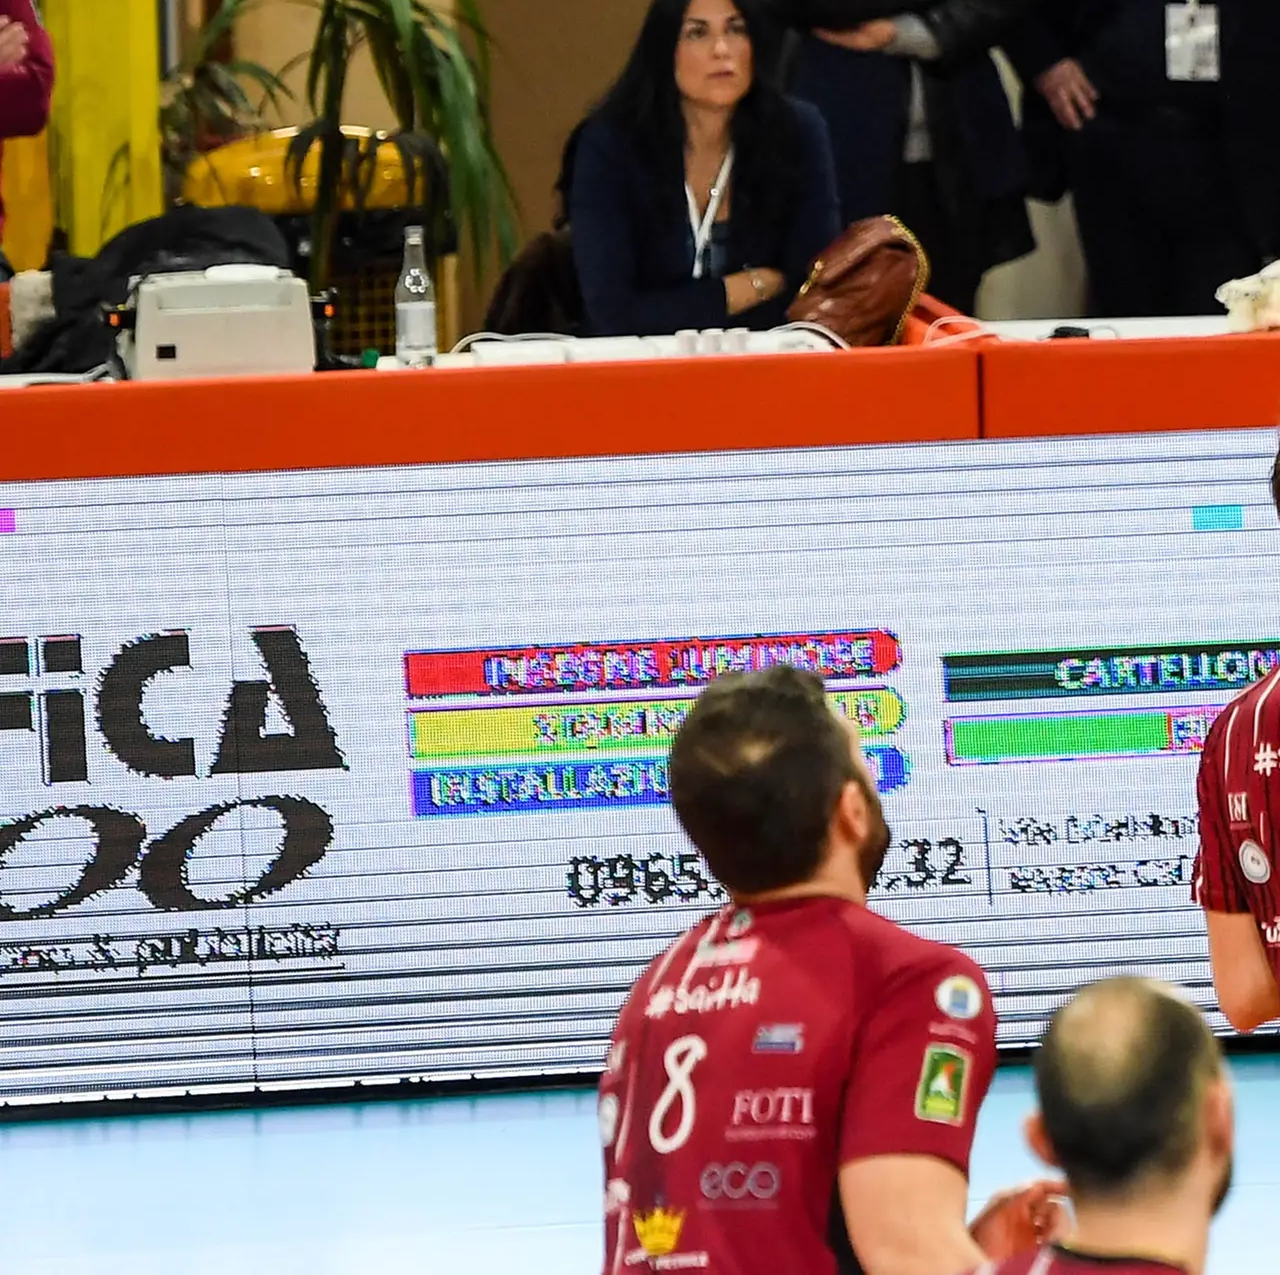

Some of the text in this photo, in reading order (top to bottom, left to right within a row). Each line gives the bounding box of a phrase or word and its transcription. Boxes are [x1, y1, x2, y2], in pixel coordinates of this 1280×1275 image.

[648, 1033, 708, 1155] 8
[731, 1087, 816, 1125] FOTI
[700, 1162, 780, 1200] eco
